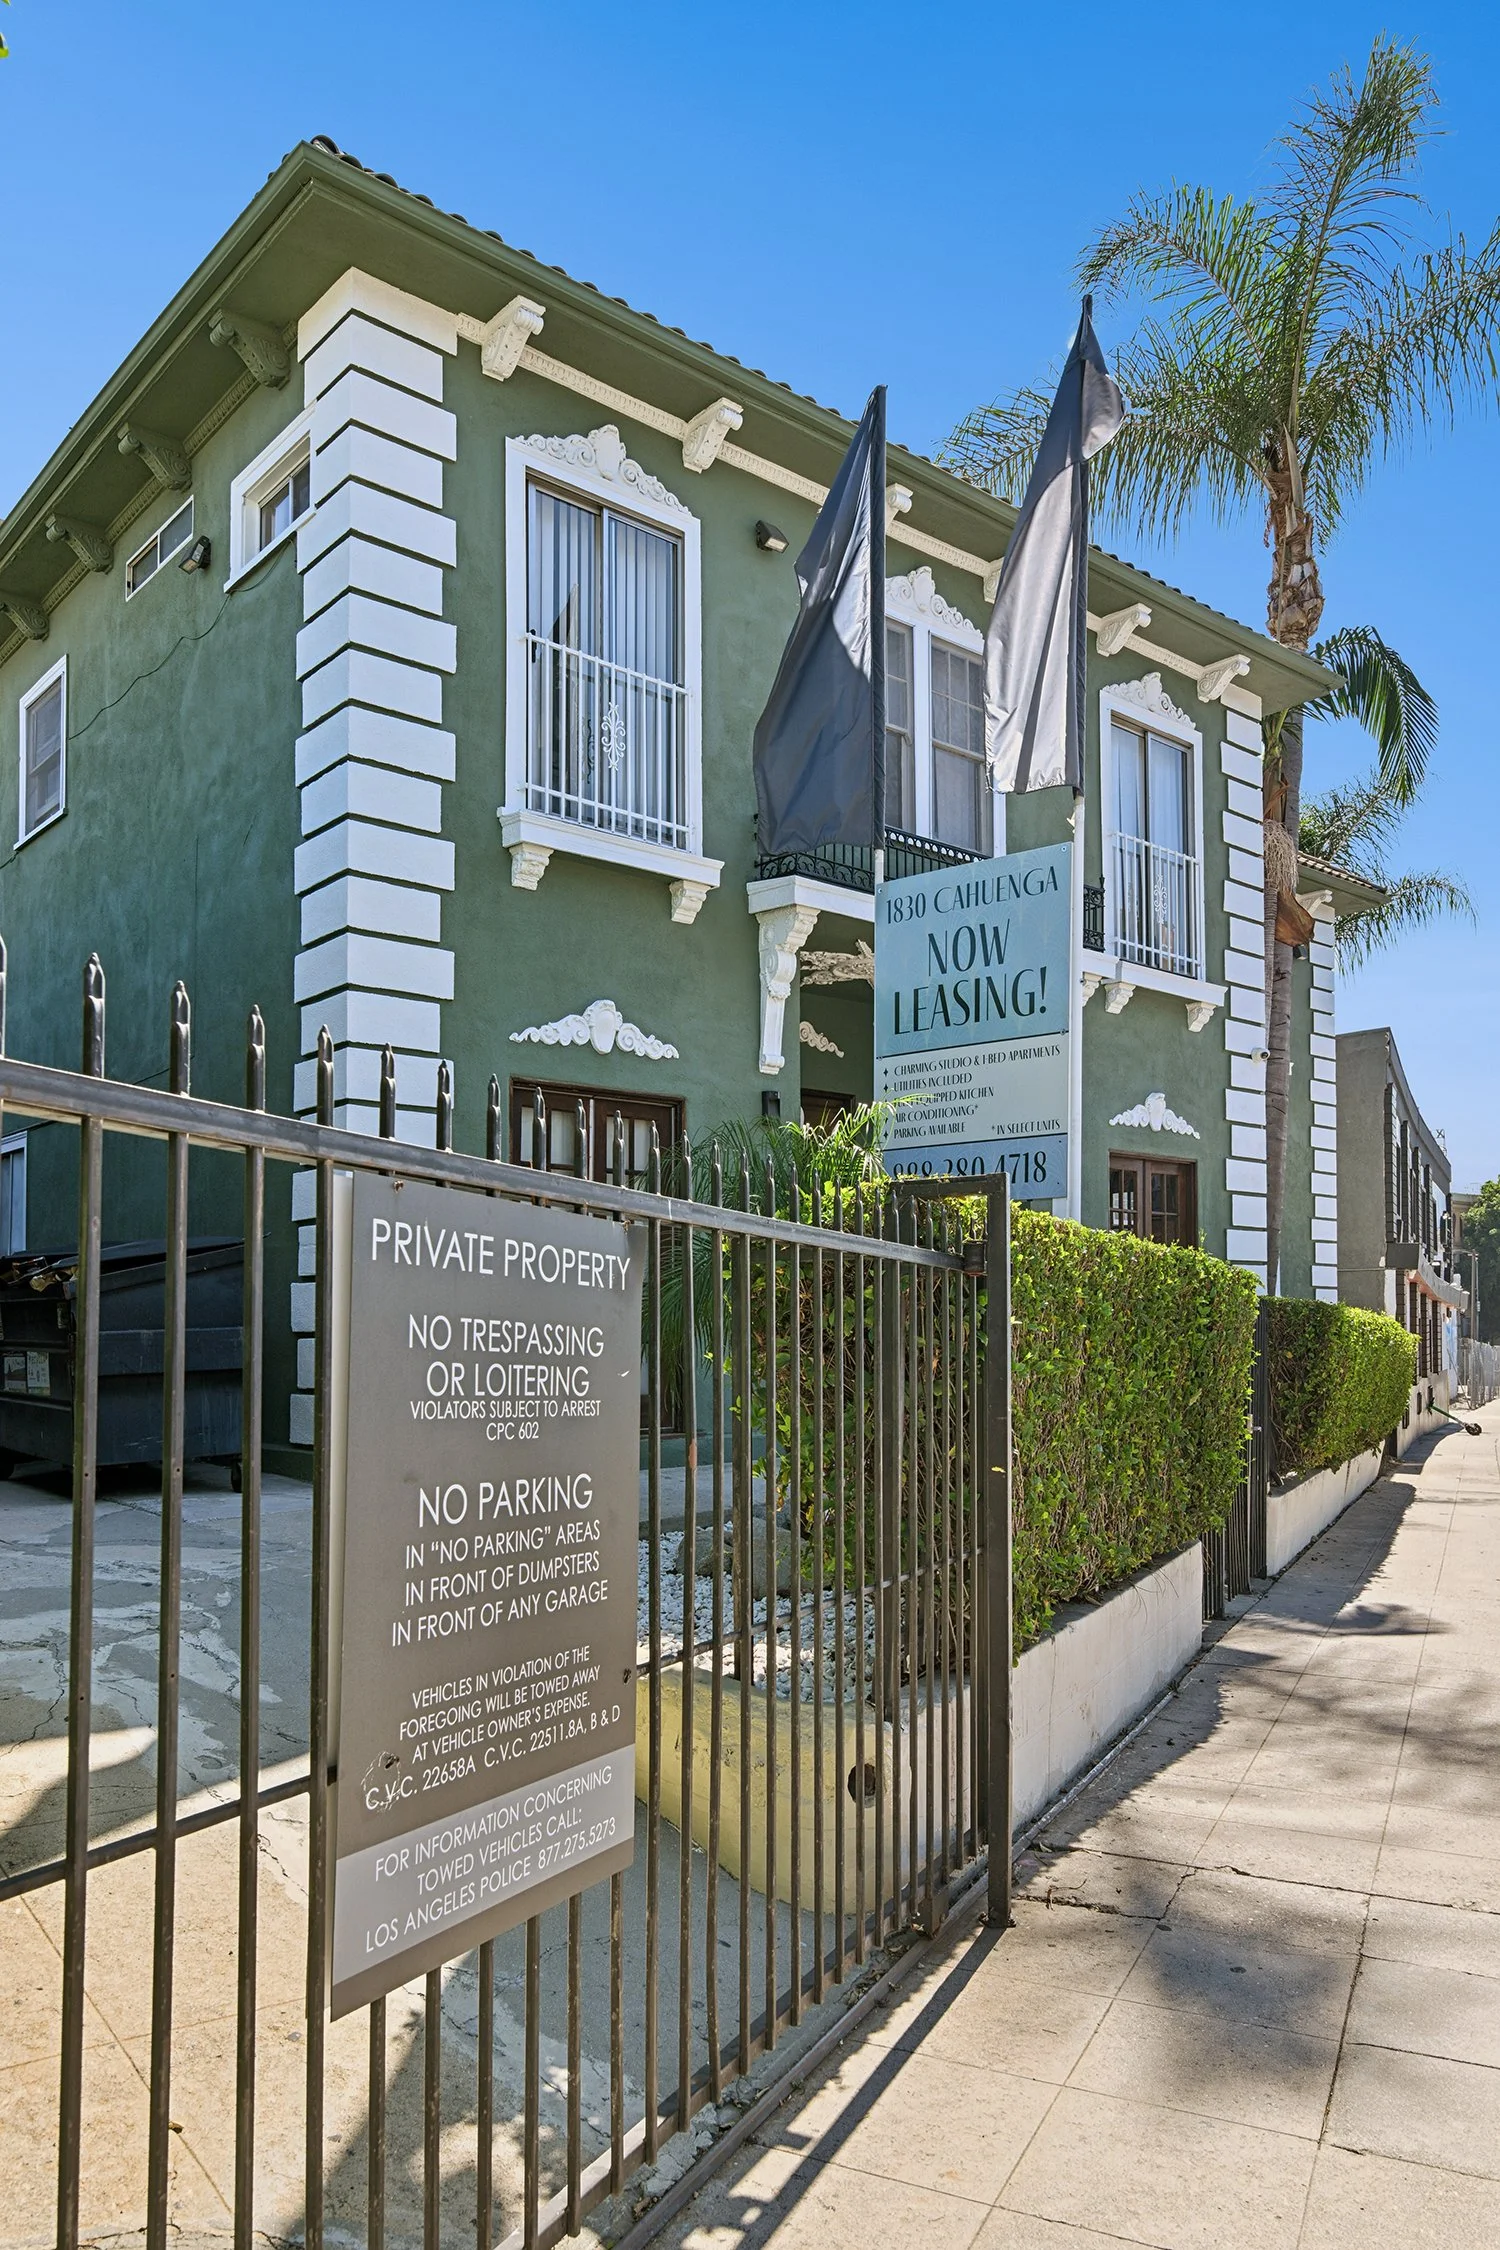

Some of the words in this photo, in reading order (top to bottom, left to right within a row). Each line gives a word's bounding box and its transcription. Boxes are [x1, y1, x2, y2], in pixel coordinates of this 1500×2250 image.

[886, 892, 927, 925] 1830
[933, 865, 1059, 914] CAHUENGA
[927, 918, 1011, 977] NOW
[894, 965, 1047, 1035] LEASING!
[893, 1060, 937, 1077] CHARMING
[938, 1056, 972, 1070] STUDIO
[973, 1055, 980, 1066] &
[1007, 1044, 1061, 1062] APARTMENTS
[893, 1078, 927, 1093] UTILITIES
[928, 1072, 973, 1088] INCLUDED
[959, 1086, 994, 1100] KITCHEN
[893, 1125, 927, 1140] PARKING
[928, 1121, 966, 1136] AVAILABLE
[1007, 1120, 1036, 1134] SELECT
[1037, 1119, 1060, 1131] UNITS
[995, 1151, 1046, 1184] 4718
[371, 1218, 495, 1275] PRIVATE
[504, 1239, 631, 1291] PROPERTY
[408, 1313, 452, 1351] NO
[460, 1317, 605, 1358] TRESPASSING
[426, 1361, 465, 1397] OR
[474, 1363, 590, 1397] LOITERING
[410, 1400, 486, 1420] VIOLATORS
[489, 1400, 540, 1418] SUBJECT
[542, 1400, 558, 1417] TO
[561, 1399, 601, 1417] ARREST
[486, 1422, 515, 1441] CPC
[518, 1421, 540, 1440] 602
[419, 1483, 468, 1528] NO
[479, 1473, 593, 1521] PARKING
[405, 1543, 424, 1569] IN
[431, 1537, 469, 1565] “NO
[474, 1526, 551, 1559] PARKING”
[555, 1519, 601, 1546] AREAS
[405, 1580, 424, 1607] IN
[430, 1569, 487, 1602] FRONT
[491, 1564, 514, 1590] OF
[518, 1550, 600, 1586] DUMPSTERS
[392, 1619, 411, 1647] IN
[417, 1606, 476, 1641] FRONT
[480, 1600, 503, 1627] OF
[508, 1592, 541, 1622] ANY
[545, 1579, 608, 1613] GARAGE
[400, 1699, 482, 1741] FOREGOING
[485, 1691, 512, 1714] WILL
[514, 1686, 528, 1706] BE
[529, 1674, 570, 1702] TOWED
[572, 1665, 601, 1689] AWAY
[412, 1676, 473, 1709] VEHICLES
[475, 1673, 488, 1693] IN
[491, 1655, 552, 1687] VIOLATION
[554, 1650, 571, 1669] OF
[572, 1645, 590, 1665] THE
[412, 1741, 428, 1764] AT
[431, 1724, 484, 1757] VEHICLE
[487, 1707, 542, 1739] OWNER'S
[544, 1690, 591, 1720] EXPENSE.
[365, 1775, 418, 1812] C.V.C.
[423, 1755, 476, 1791] 22658A
[484, 1737, 527, 1769] C.V.C.
[530, 1717, 587, 1752] 22511.8A,
[590, 1714, 598, 1731] B
[600, 1709, 610, 1726] &
[612, 1704, 621, 1722] D
[375, 1847, 410, 1882] FOR
[414, 1806, 520, 1865] INFORMATION
[523, 1765, 613, 1818] CONCERNING
[417, 1853, 475, 1895] TOWED
[479, 1825, 543, 1865] VEHICLES
[546, 1807, 583, 1837] CALL:
[366, 1917, 399, 1954] LOS
[404, 1881, 476, 1935] ANGELES
[480, 1854, 532, 1898] POLICE
[538, 1816, 616, 1871] 877.275.5273
